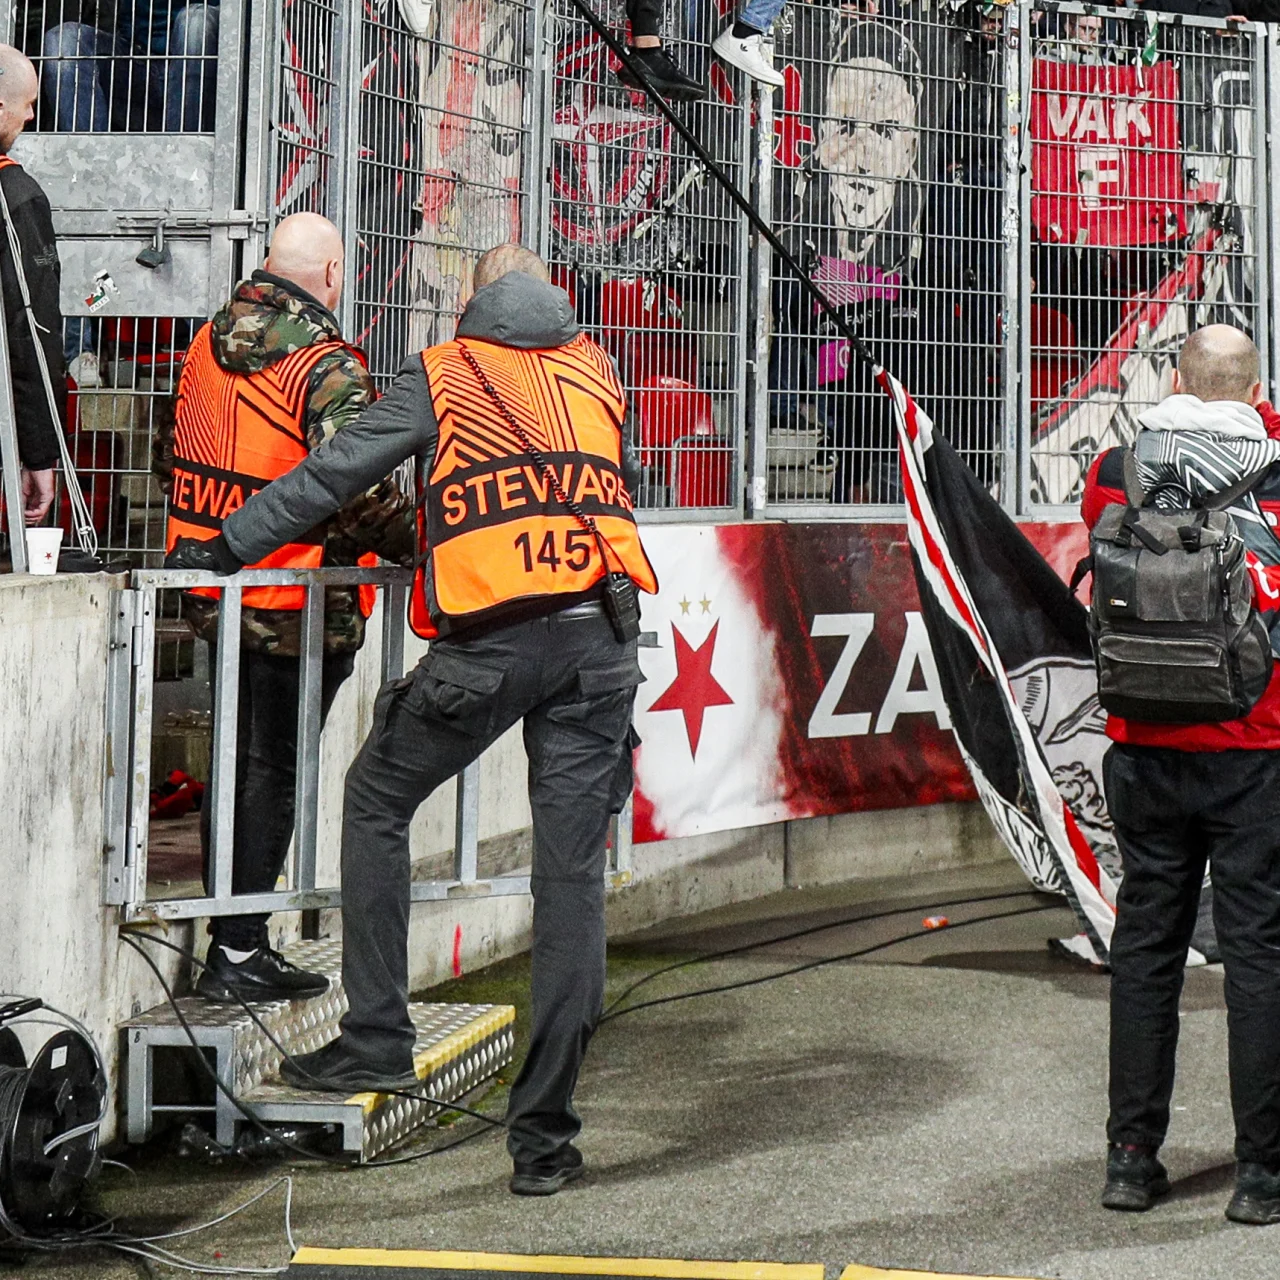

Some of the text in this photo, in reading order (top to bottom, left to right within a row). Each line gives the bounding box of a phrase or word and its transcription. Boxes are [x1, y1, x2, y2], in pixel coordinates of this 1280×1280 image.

[1046, 88, 1153, 140] VAK
[173, 467, 261, 520] TEWA
[514, 529, 590, 573] 145
